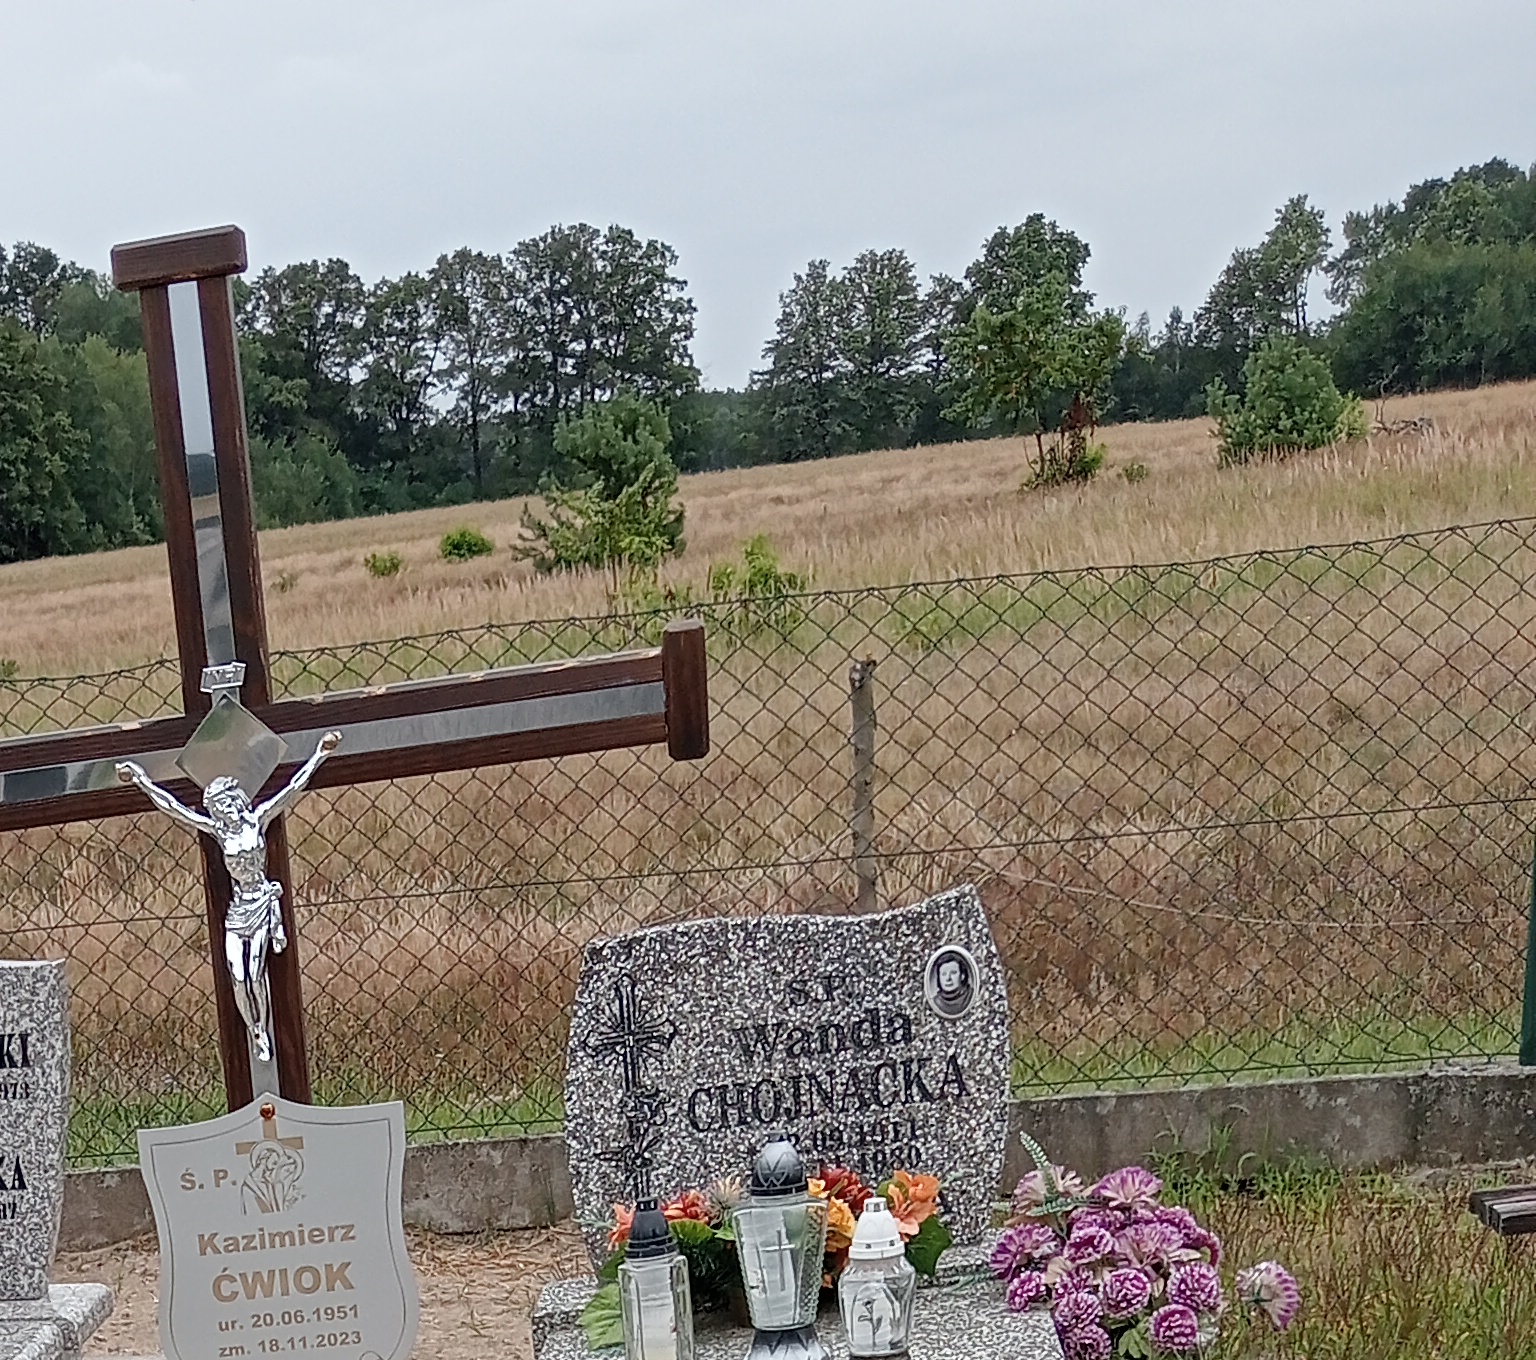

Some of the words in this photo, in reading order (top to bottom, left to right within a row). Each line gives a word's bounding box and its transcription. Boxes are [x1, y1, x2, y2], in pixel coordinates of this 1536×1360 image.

[732, 1006, 915, 1061] Wanda
[687, 1052, 972, 1132] CHOJNACKA
[197, 1223, 356, 1256] Kazimierz
[212, 1261, 355, 1303] ĆWIOK
[218, 1318, 245, 1333] ur.
[251, 1304, 360, 1329] 20.06.1951
[219, 1345, 252, 1358] zm.
[257, 1330, 362, 1354] 18.11.2023
